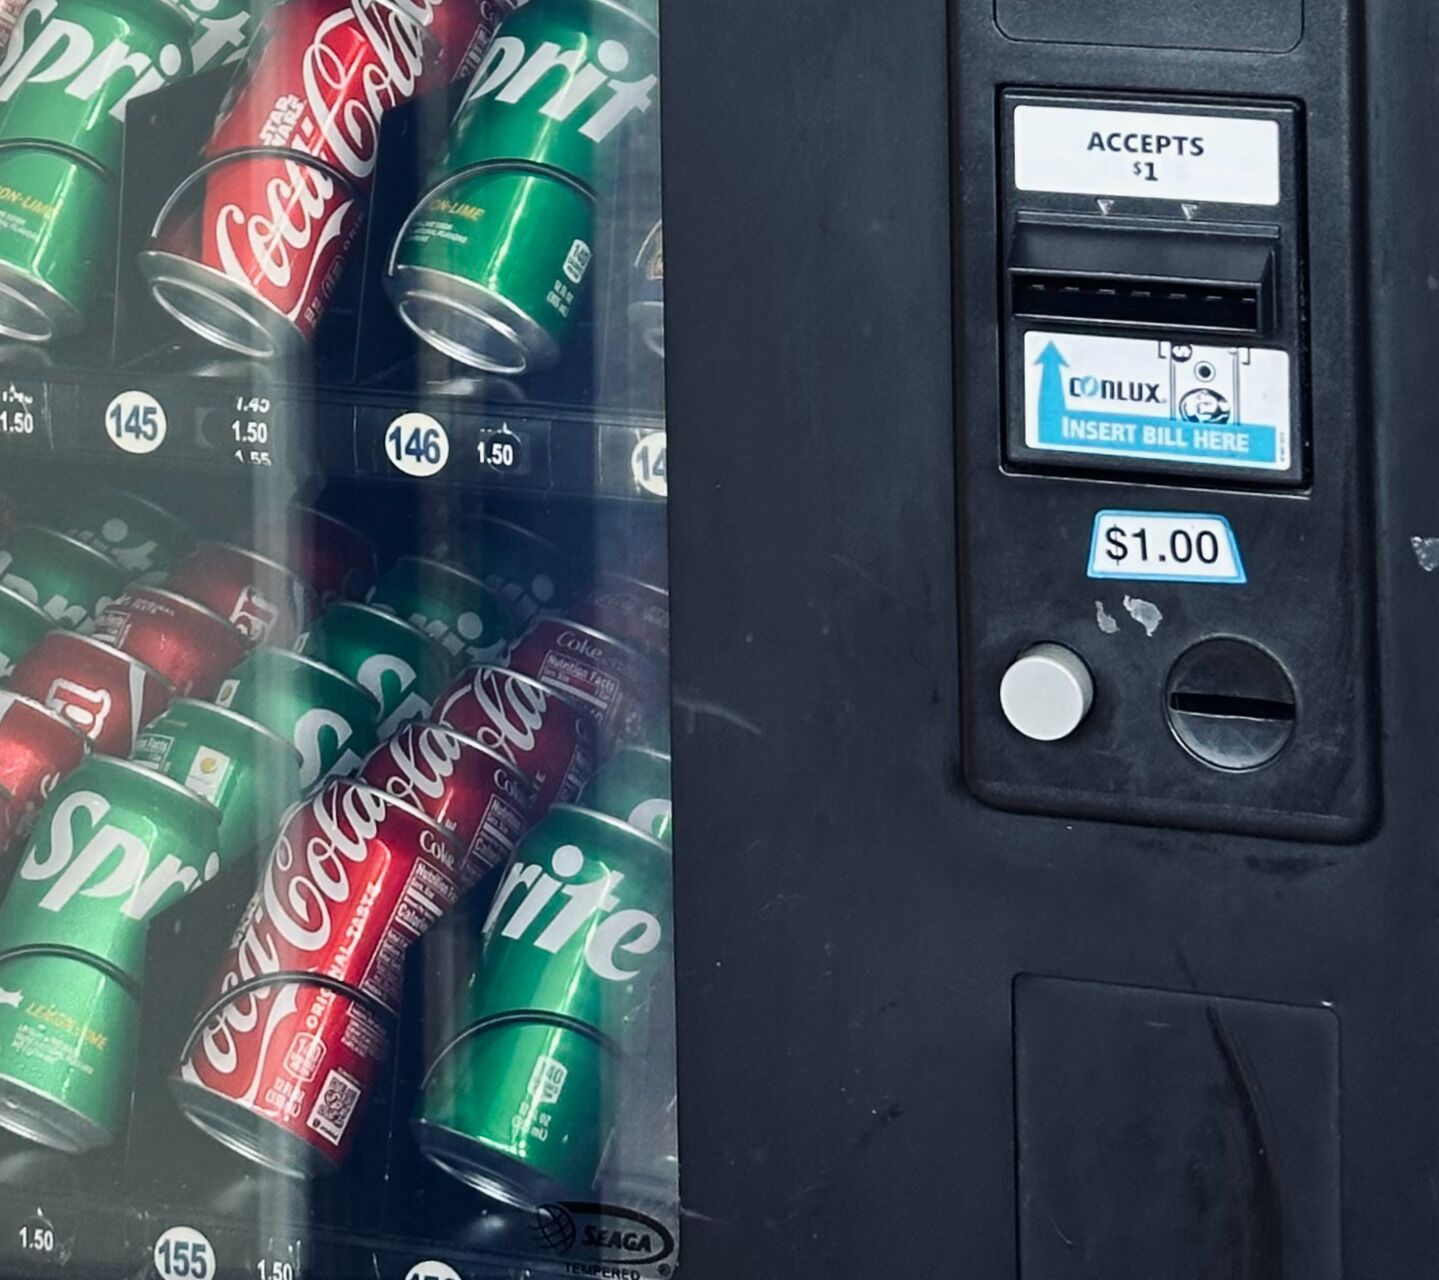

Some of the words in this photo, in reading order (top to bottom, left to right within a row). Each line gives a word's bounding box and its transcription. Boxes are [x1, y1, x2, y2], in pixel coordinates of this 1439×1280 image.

[1086, 130, 1205, 157] ACCEPTS
[1131, 160, 1159, 183] $1
[0, 412, 35, 435] 1.50
[109, 403, 159, 441] 145
[232, 421, 268, 444] 1.50
[1062, 416, 1136, 442] INSERT
[1143, 422, 1188, 448] BILL
[1192, 426, 1250, 452] HERE
[387, 426, 442, 465] 146
[476, 442, 514, 466] 1.50
[1105, 526, 1220, 566] $1.00
[19, 1228, 54, 1252] 1.50
[583, 1224, 653, 1254] SEAGA
[158, 1242, 208, 1278] 155
[257, 1260, 294, 1280] 1.50
